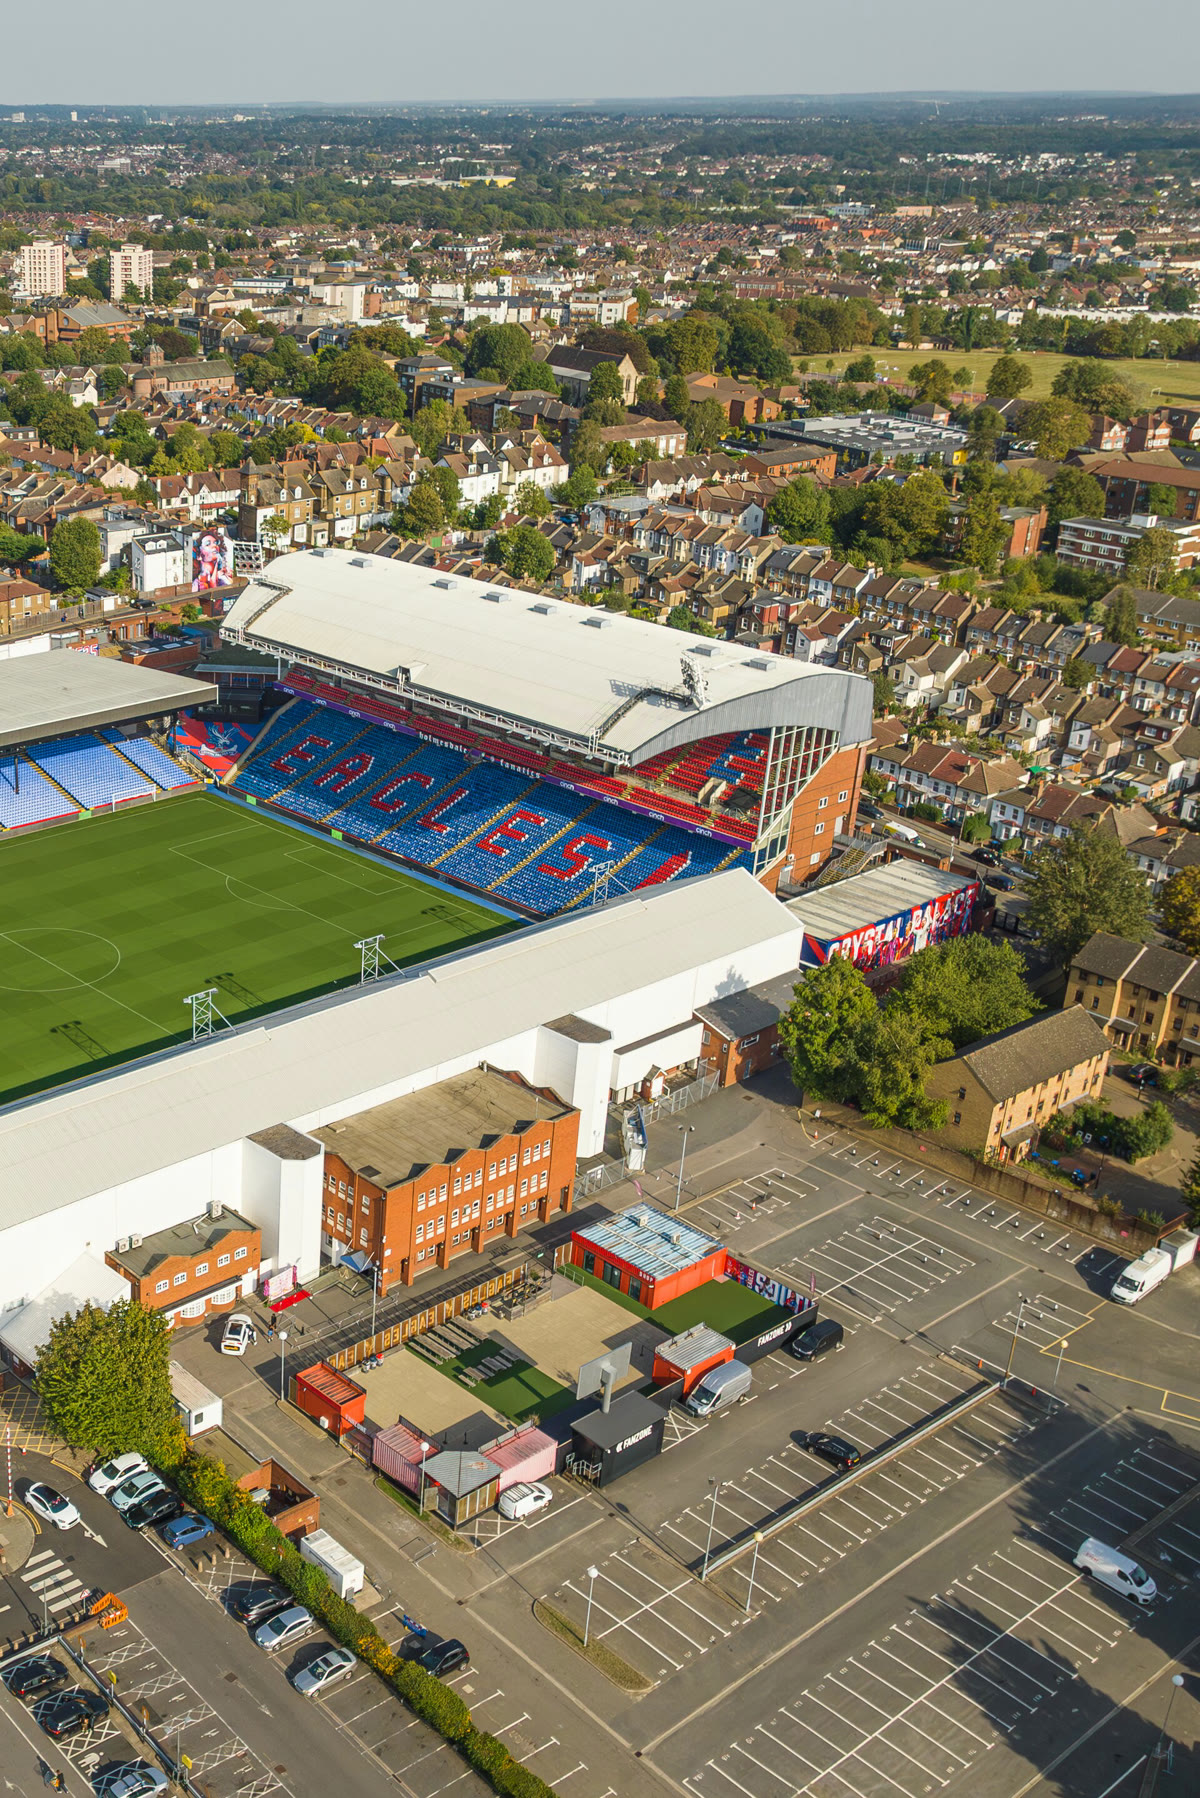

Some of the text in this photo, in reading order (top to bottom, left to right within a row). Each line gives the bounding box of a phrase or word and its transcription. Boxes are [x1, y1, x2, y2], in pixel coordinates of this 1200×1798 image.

[559, 781, 575, 792] cinch
[603, 795, 619, 806] cinch
[648, 811, 665, 822] cinch
[695, 826, 713, 838] cinch
[827, 887, 977, 964] CRYSTAL PALACE
[757, 1324, 786, 1347] FANZONE
[623, 1425, 653, 1450] FANZONE
